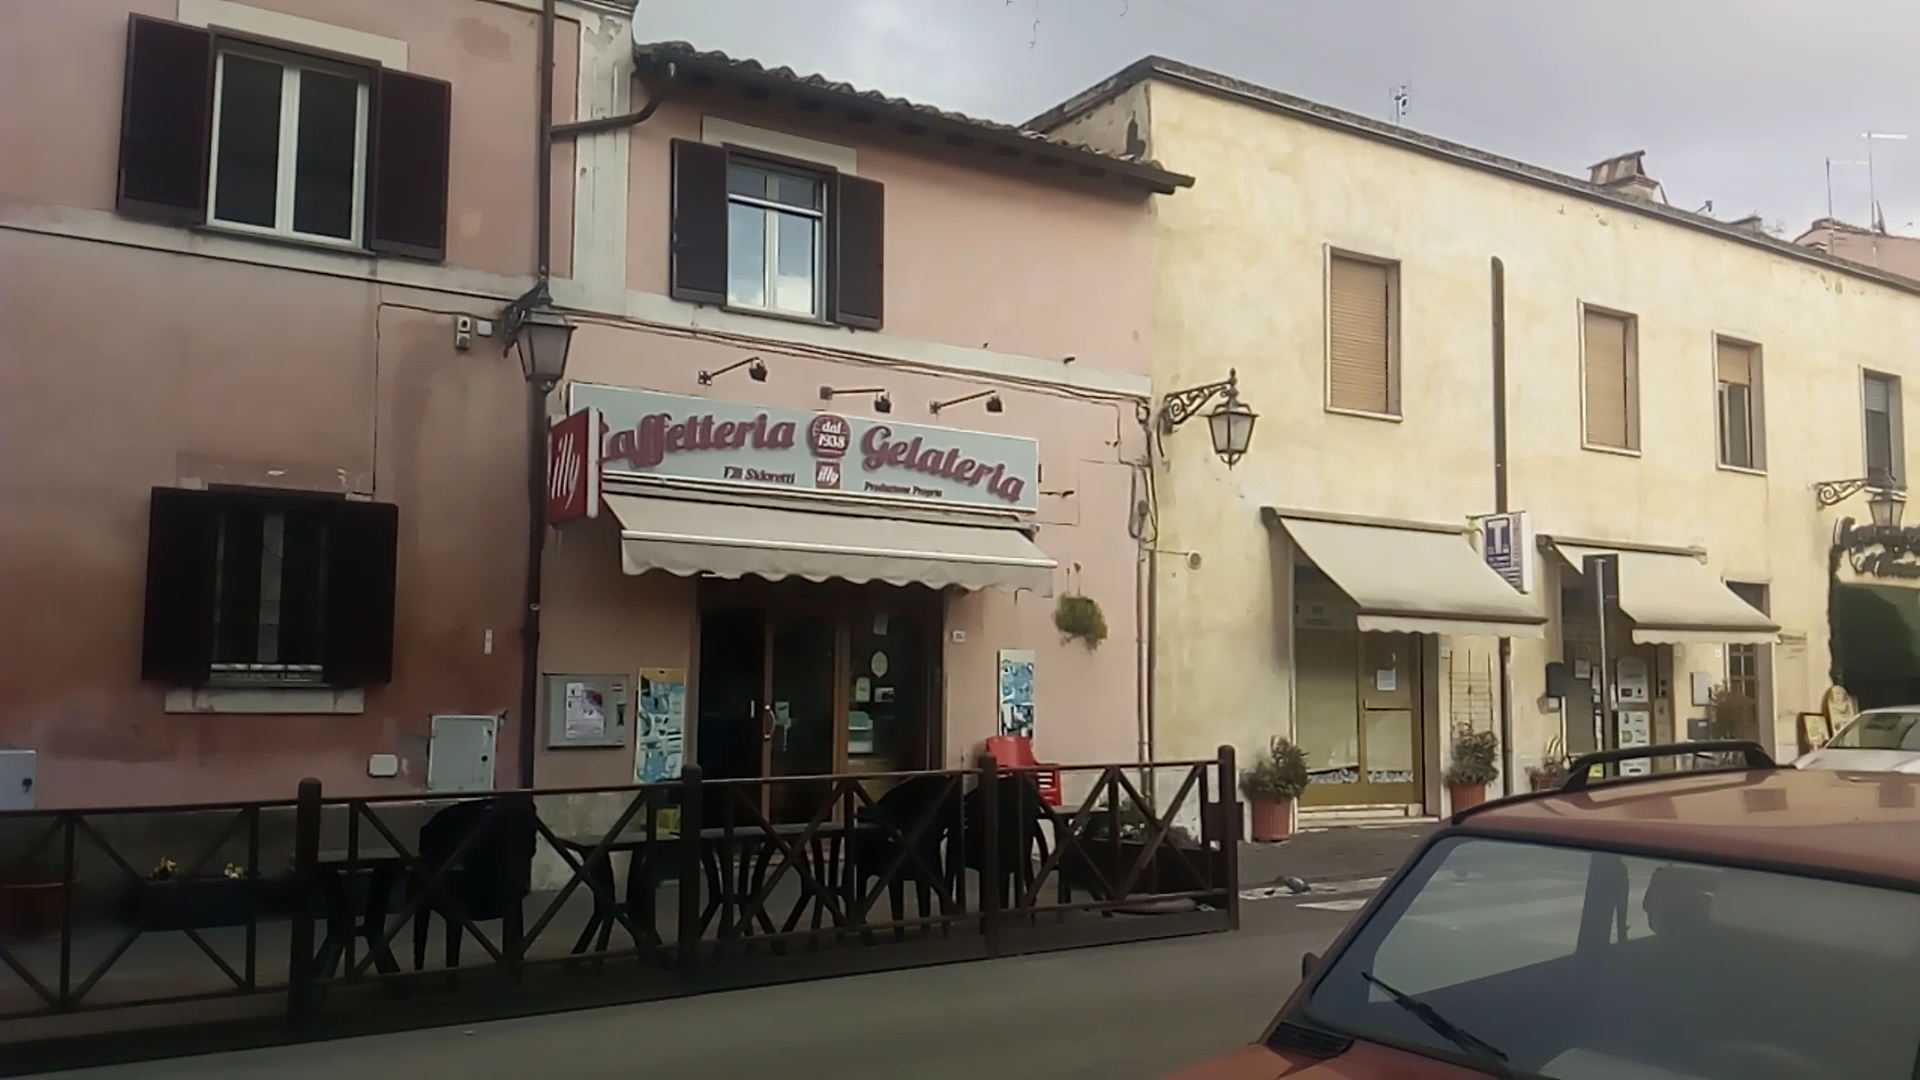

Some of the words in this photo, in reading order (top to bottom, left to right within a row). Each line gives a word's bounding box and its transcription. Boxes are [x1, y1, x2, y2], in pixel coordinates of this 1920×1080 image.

[599, 413, 796, 468] affetteria
[818, 433, 845, 448] 1938
[822, 421, 841, 434] dal
[551, 432, 580, 510] illy
[817, 465, 839, 486] illy
[860, 425, 1025, 501] Gelateria
